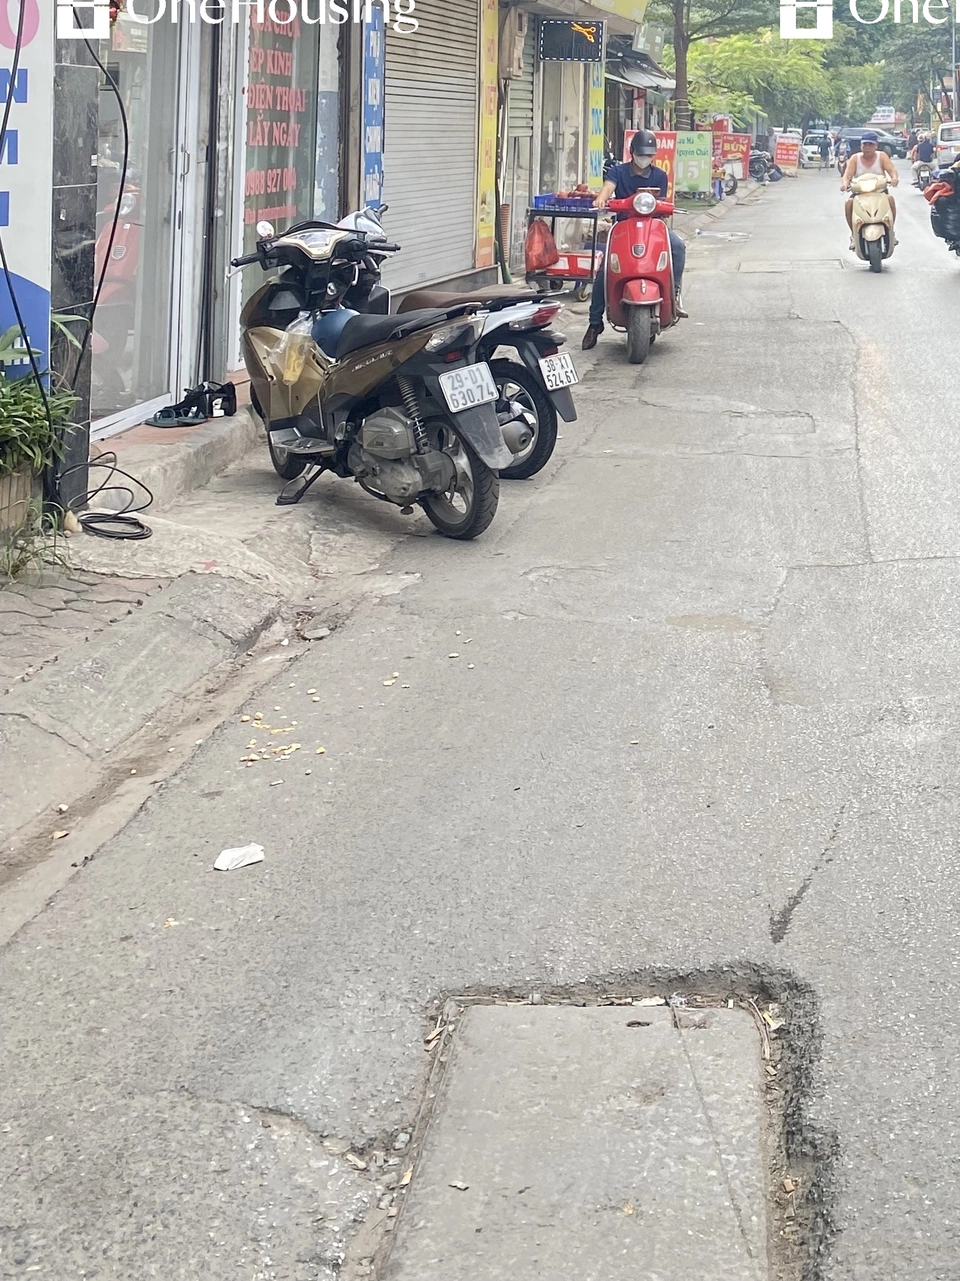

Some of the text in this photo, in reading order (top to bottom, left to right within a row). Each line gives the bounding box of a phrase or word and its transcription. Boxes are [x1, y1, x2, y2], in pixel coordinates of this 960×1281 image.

[266, 42, 292, 76] KÍNH
[247, 77, 306, 116] ĐIỆN THOẠI
[272, 121, 301, 148] NGAY
[546, 353, 570, 369] 38-X1
[448, 367, 485, 392] 29-D1
[547, 370, 578, 388] 524.61
[450, 382, 495, 409] 630.74
